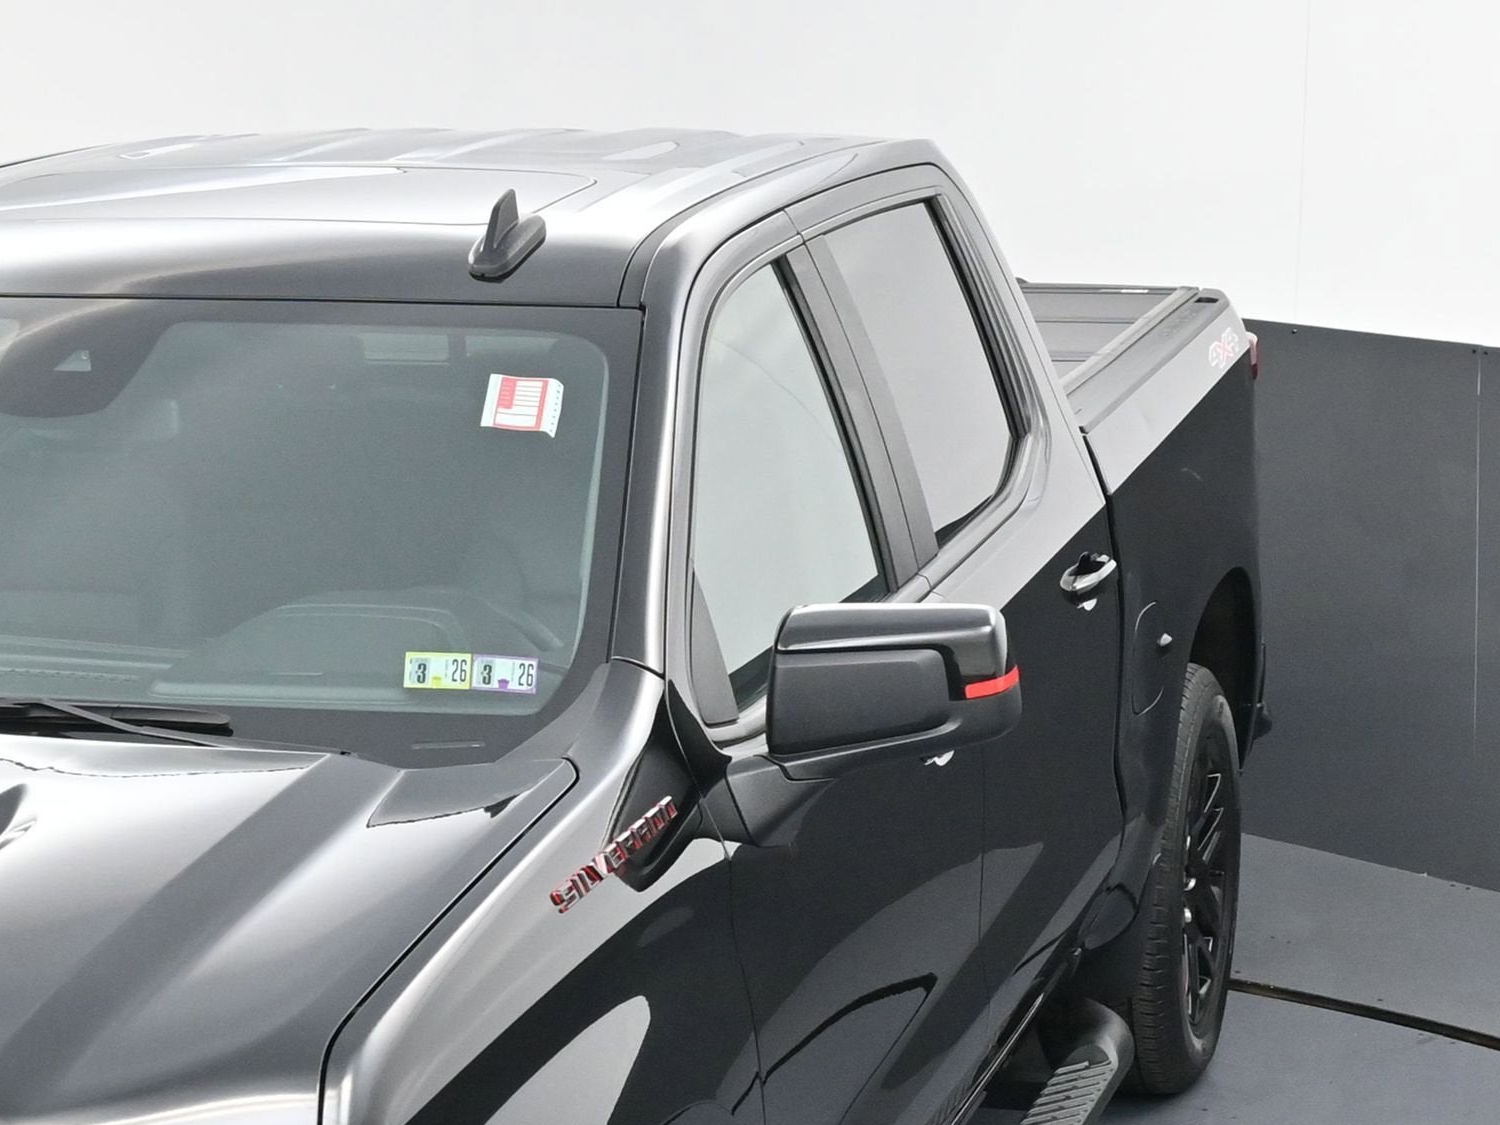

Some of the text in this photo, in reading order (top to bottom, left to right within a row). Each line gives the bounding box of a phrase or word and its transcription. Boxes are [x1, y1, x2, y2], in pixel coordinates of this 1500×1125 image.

[416, 659, 468, 684] 3 26
[482, 663, 535, 687] 3 26
